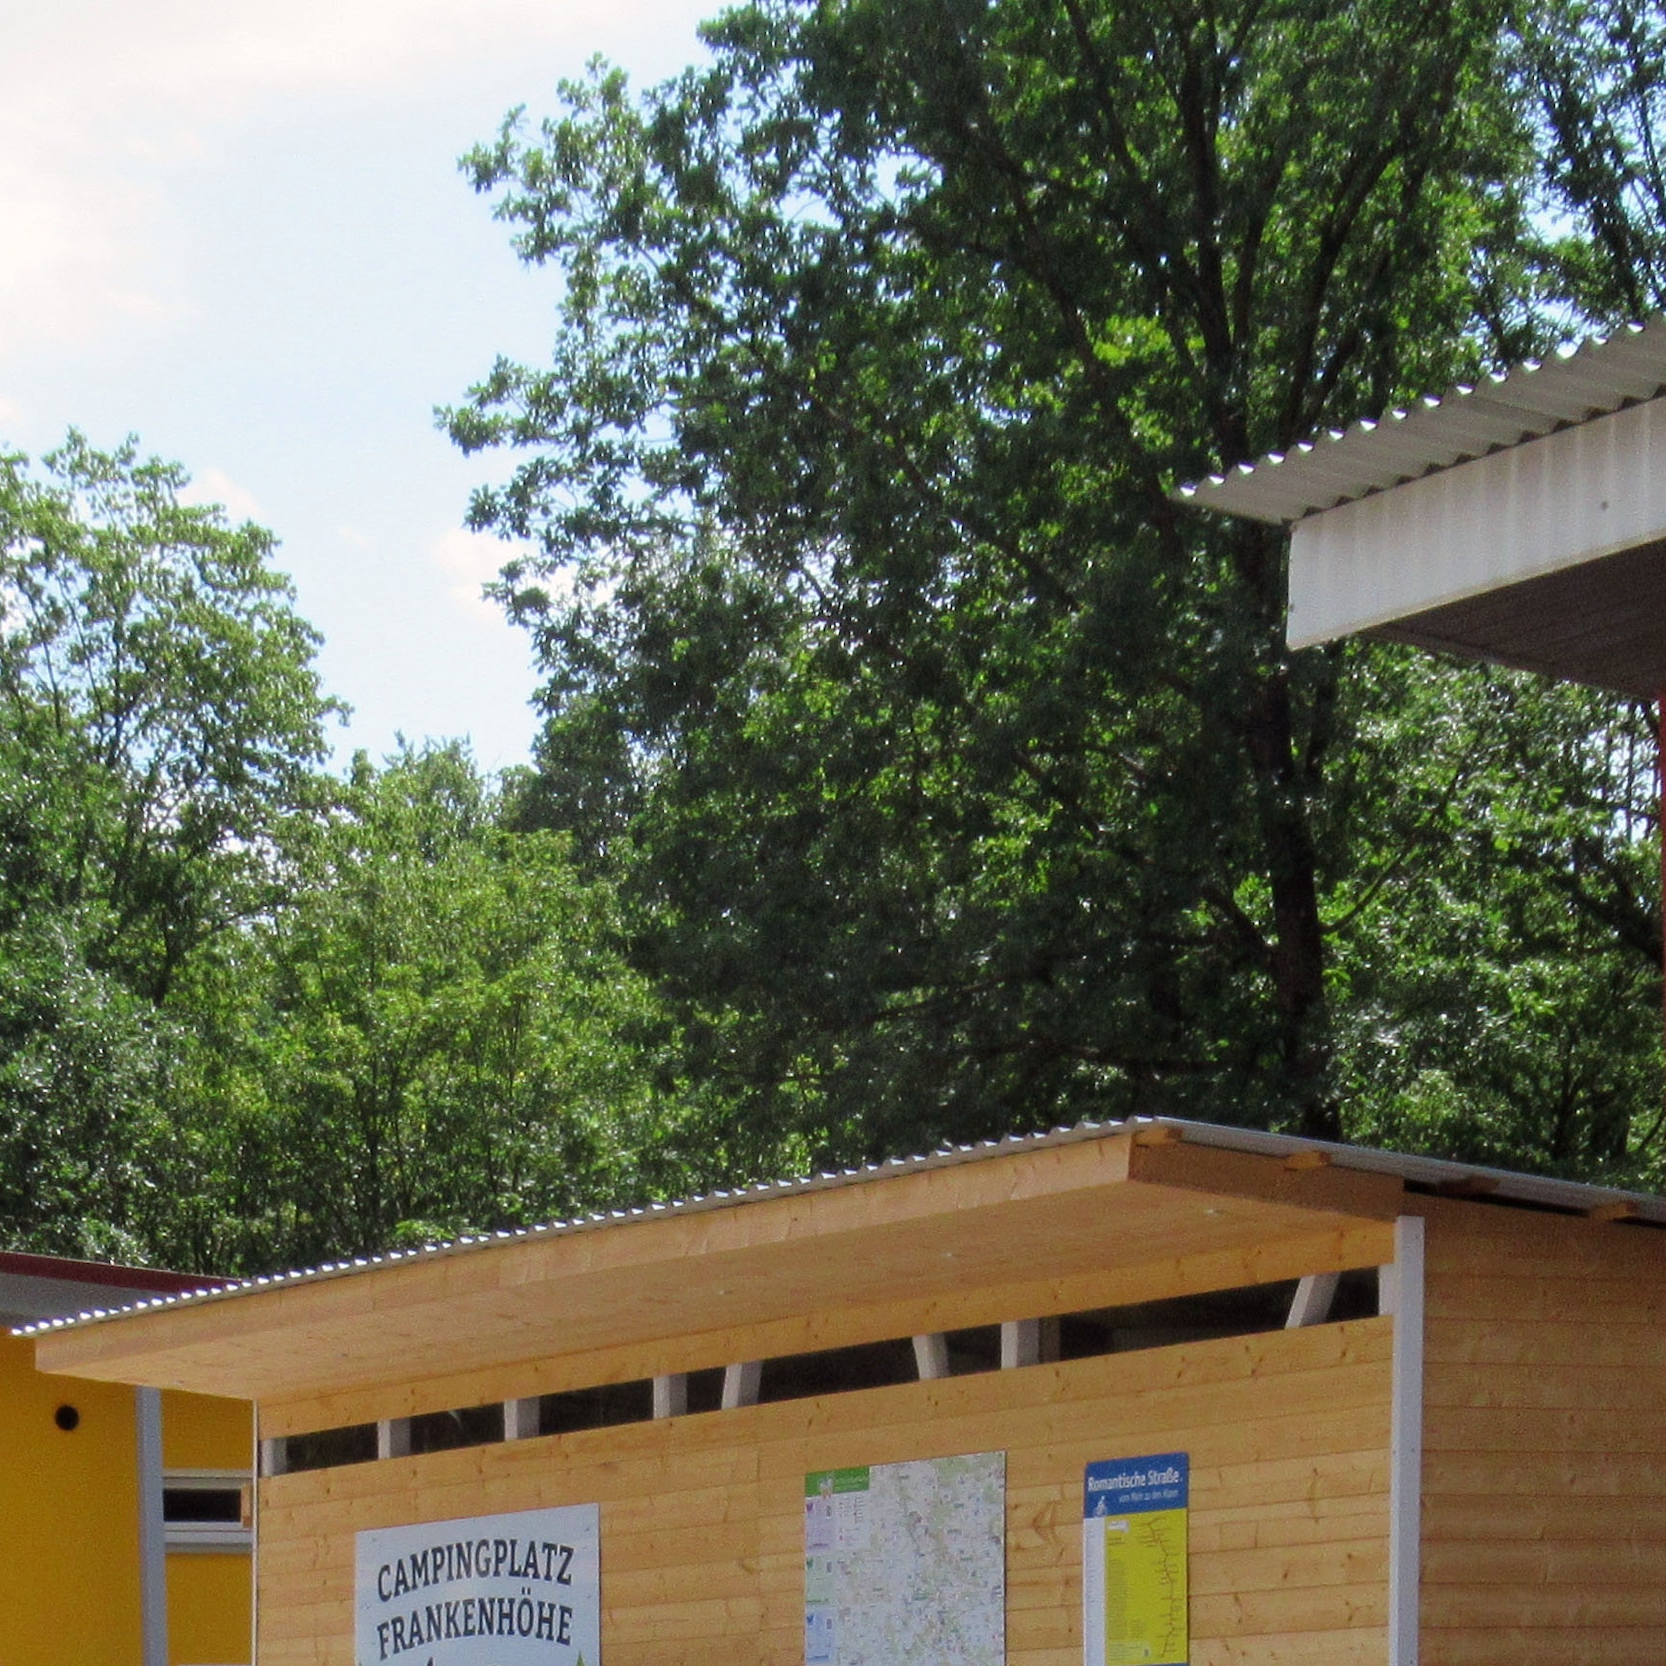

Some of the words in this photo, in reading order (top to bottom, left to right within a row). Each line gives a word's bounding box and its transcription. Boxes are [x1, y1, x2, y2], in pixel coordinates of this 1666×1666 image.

[1088, 1471, 1146, 1491] Romantische
[1148, 1467, 1180, 1484] Straße
[378, 1539, 574, 1602] CAMPINGPLATZ
[377, 1587, 573, 1660] FRANKENHÖHE
